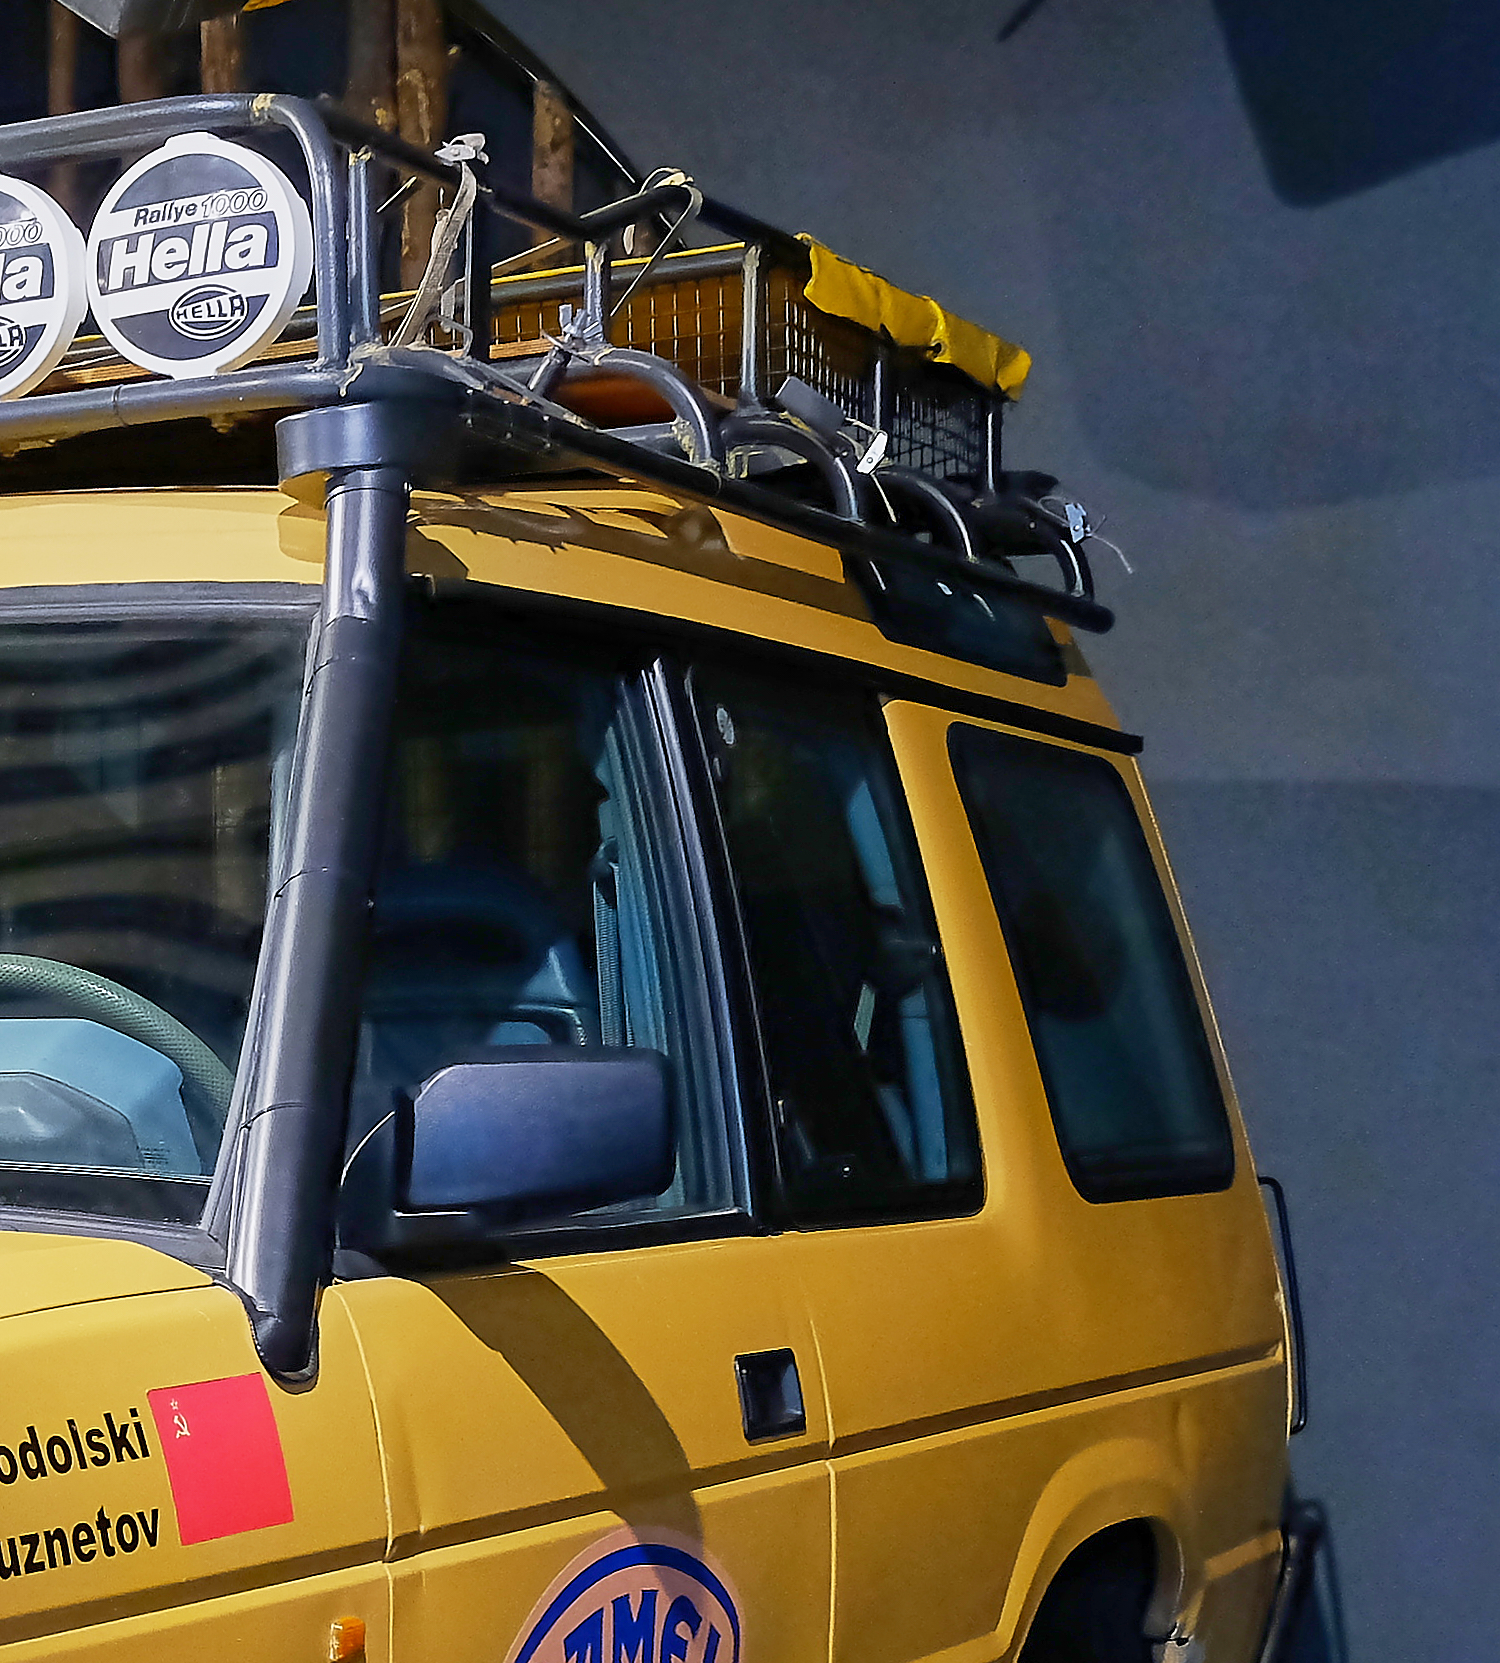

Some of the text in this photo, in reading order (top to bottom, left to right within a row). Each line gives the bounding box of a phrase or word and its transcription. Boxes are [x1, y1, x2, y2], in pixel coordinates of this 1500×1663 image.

[134, 189, 268, 227] Rallye 1000
[107, 220, 268, 291] Hella
[176, 294, 245, 321] HELLA
